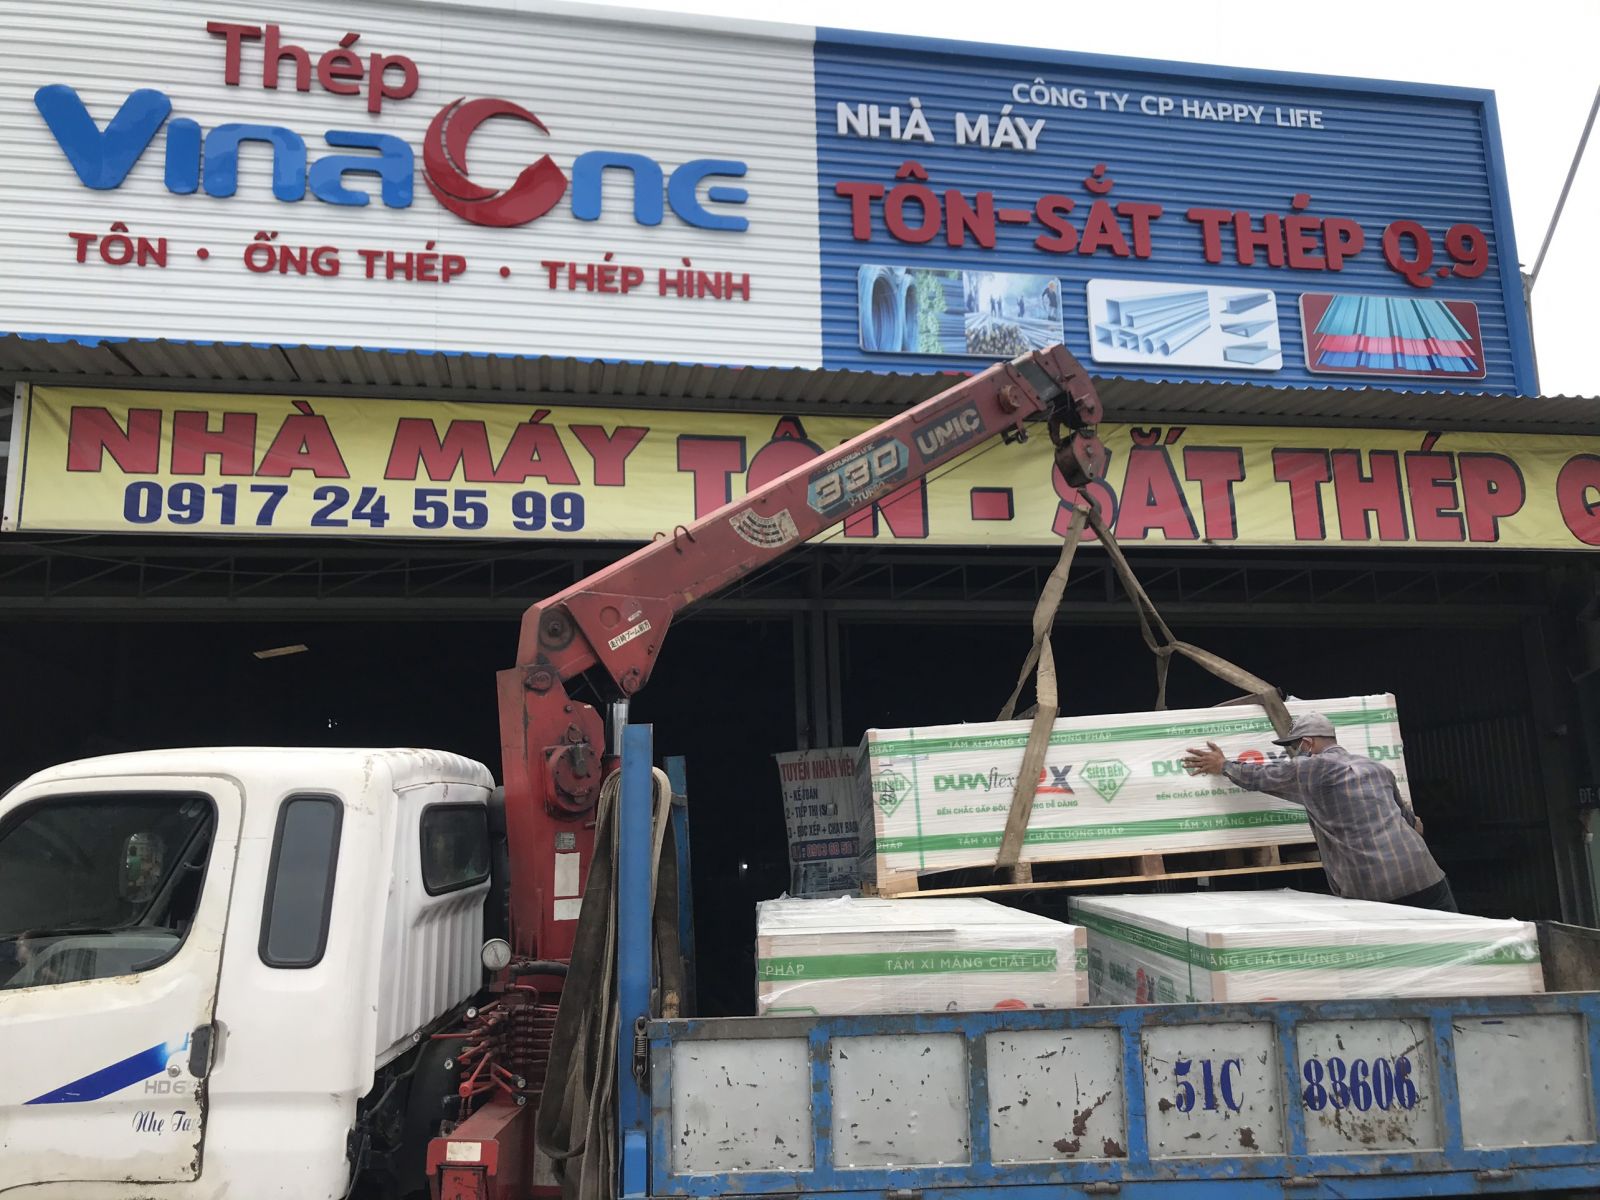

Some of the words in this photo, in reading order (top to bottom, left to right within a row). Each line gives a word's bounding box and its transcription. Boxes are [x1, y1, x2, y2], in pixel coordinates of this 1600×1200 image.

[207, 22, 419, 114] Thép
[836, 97, 935, 143] NHÀ
[955, 104, 1046, 150] MÁY
[1012, 77, 1087, 109] CÔNG
[1095, 90, 1129, 112] TY
[1140, 95, 1174, 116] CP
[1182, 99, 1264, 124] HAPPY
[1276, 107, 1324, 129] LIFE
[68, 222, 167, 267] TÔN
[244, 231, 340, 277] ỐNG
[358, 240, 467, 282] THÉP
[541, 252, 644, 294] THÉP
[659, 257, 749, 301] HÌNH
[1187, 193, 1365, 271] THÉP
[1382, 220, 1488, 288] Q.9
[916, 408, 980, 455] UNIC
[67, 401, 350, 478] NHÀ
[384, 409, 649, 486] MÁY
[1051, 427, 1246, 542] SẮT
[1272, 431, 1526, 543] THÉP
[815, 442, 899, 508] 330
[123, 481, 289, 527] 0917
[311, 485, 390, 528] 24
[412, 488, 489, 530] 55
[512, 491, 586, 532] 99
[921, 957, 934, 970] XI
[1174, 1057, 1244, 1114] 51C
